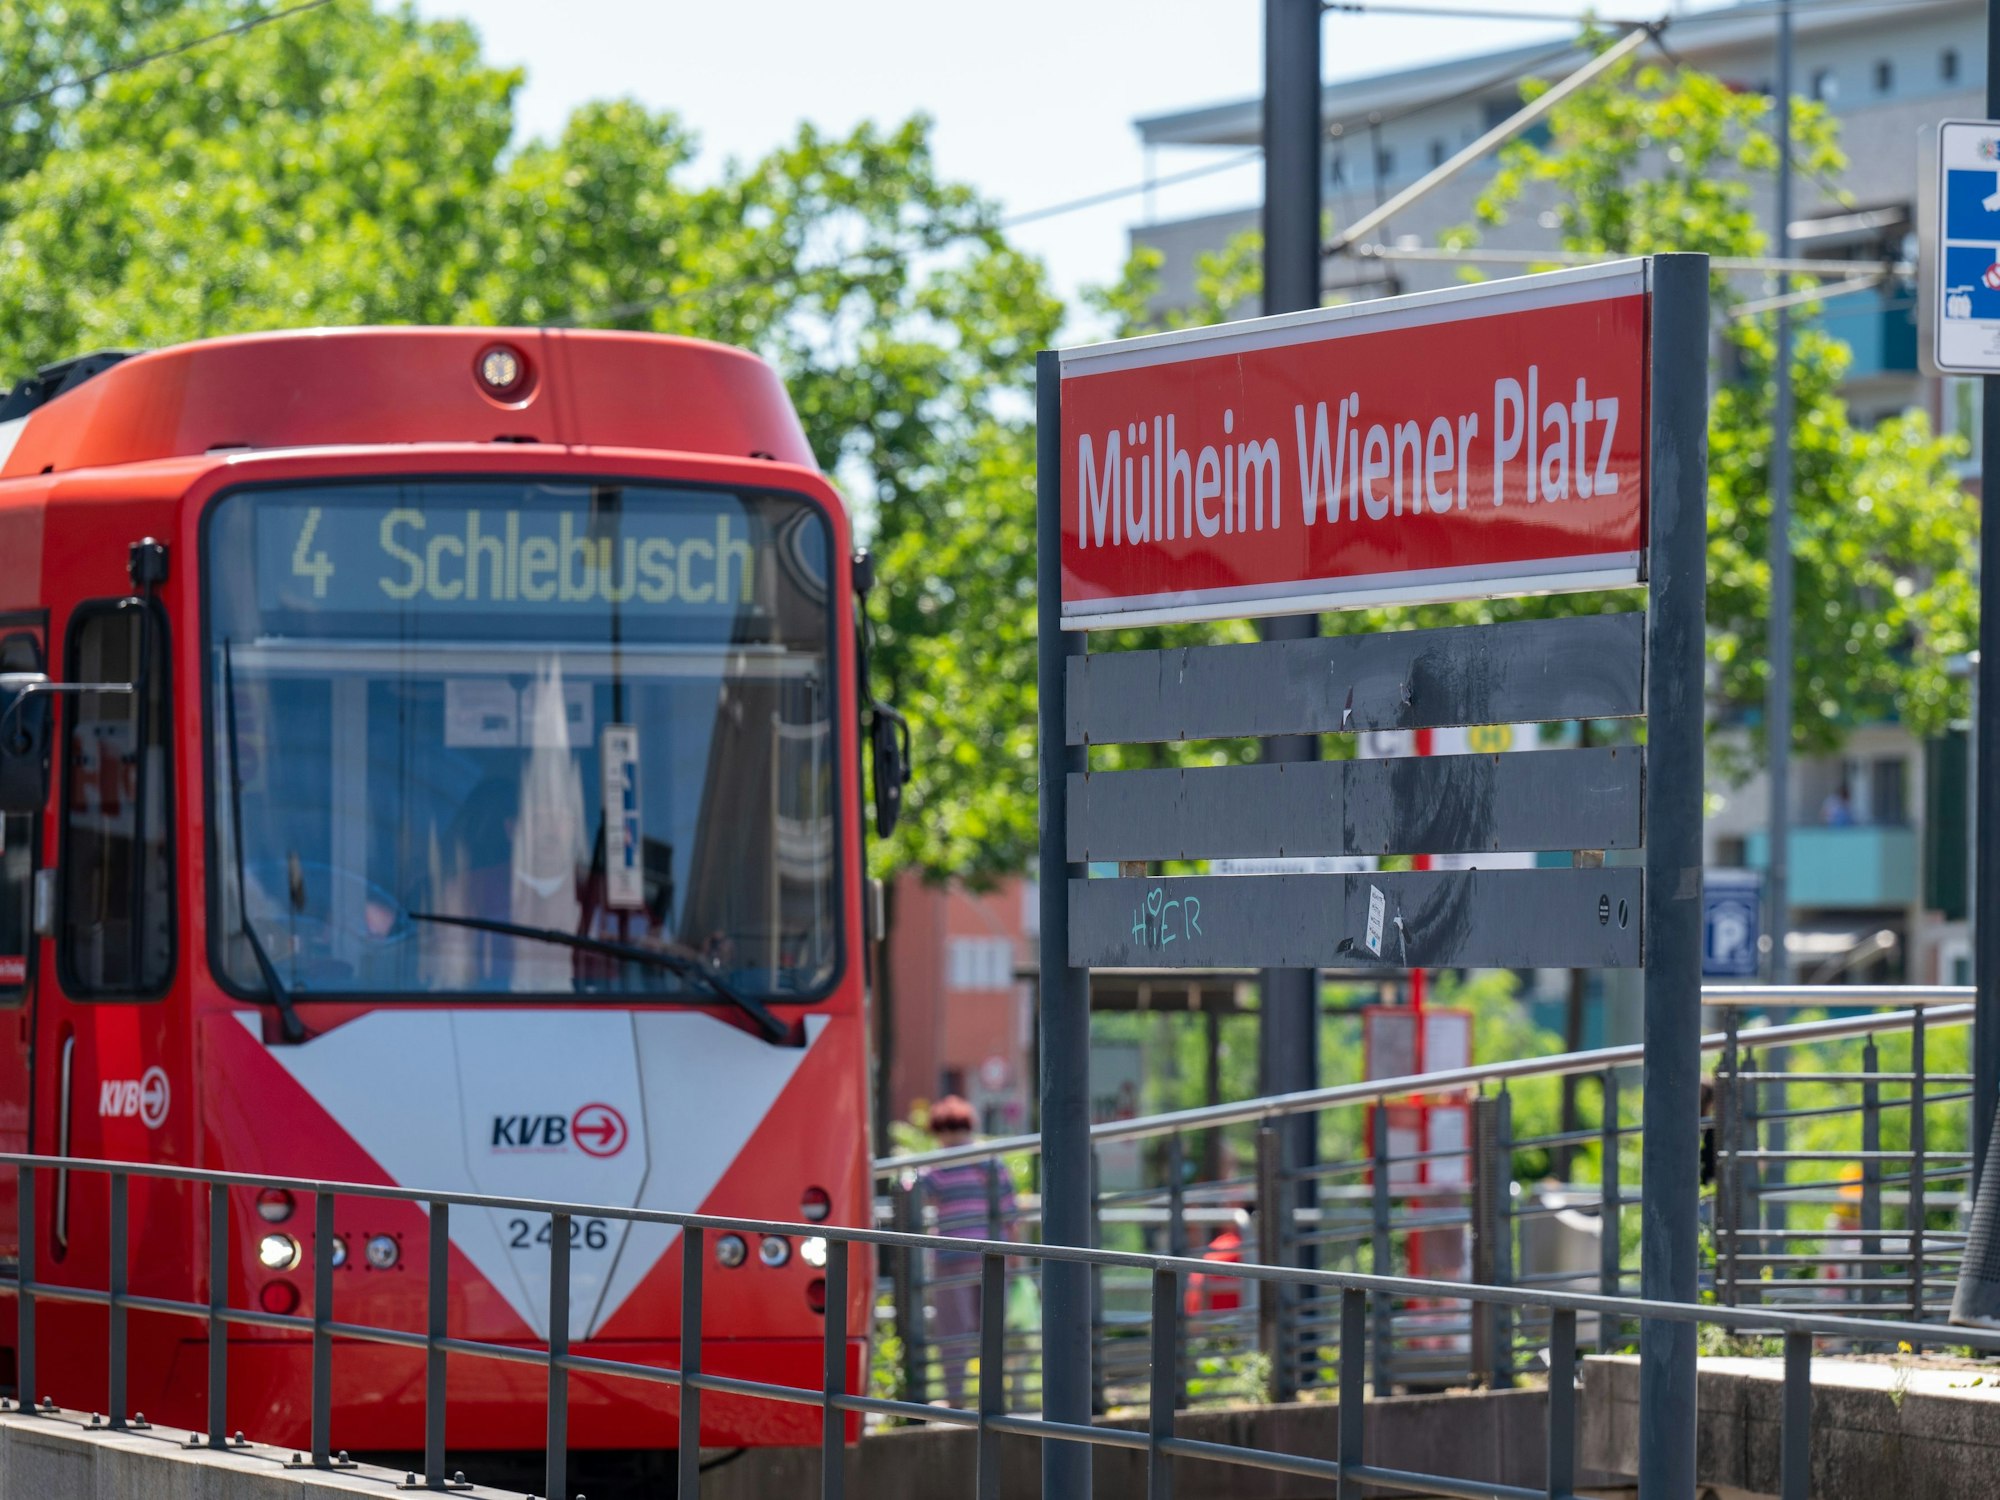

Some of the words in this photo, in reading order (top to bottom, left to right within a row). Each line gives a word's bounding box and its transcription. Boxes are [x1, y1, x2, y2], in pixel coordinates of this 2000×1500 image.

[1078, 408, 1281, 549] Mülheim
[1294, 391, 1479, 527] Wiener
[1493, 364, 1620, 507] Platz
[292, 507, 333, 598] 4
[378, 508, 755, 604] Schlebusch
[99, 1080, 141, 1117] KVB
[491, 1115, 568, 1146] KVB
